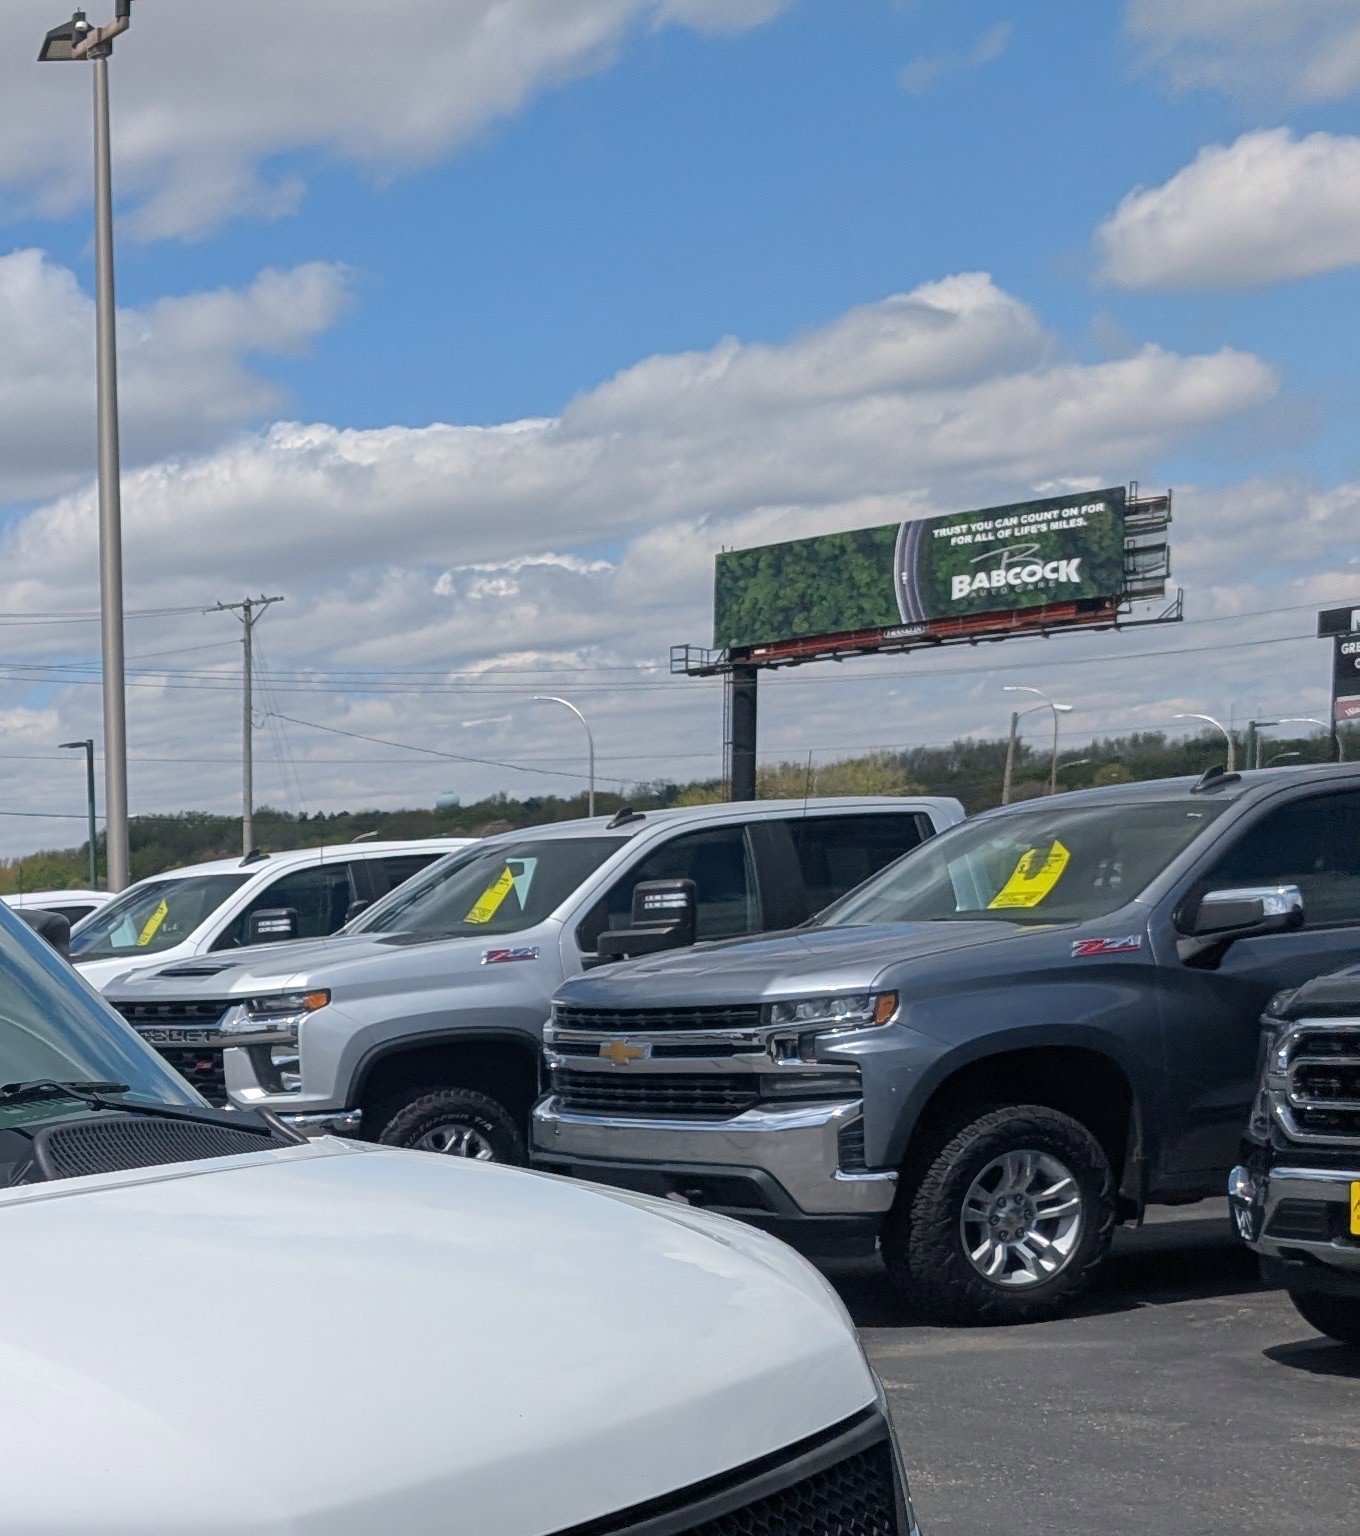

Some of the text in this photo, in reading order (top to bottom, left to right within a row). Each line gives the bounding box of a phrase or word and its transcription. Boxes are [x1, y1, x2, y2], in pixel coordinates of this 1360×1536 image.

[932, 502, 1106, 538] TRUST YOU CAN COUNT ON FOR
[950, 536, 974, 546] FOR
[973, 532, 996, 543] ALL
[996, 528, 1013, 539] OF
[1013, 523, 1048, 537] LIFE'S
[951, 557, 1082, 600] BABCOCK
[969, 578, 1058, 598] AUTO CARE
